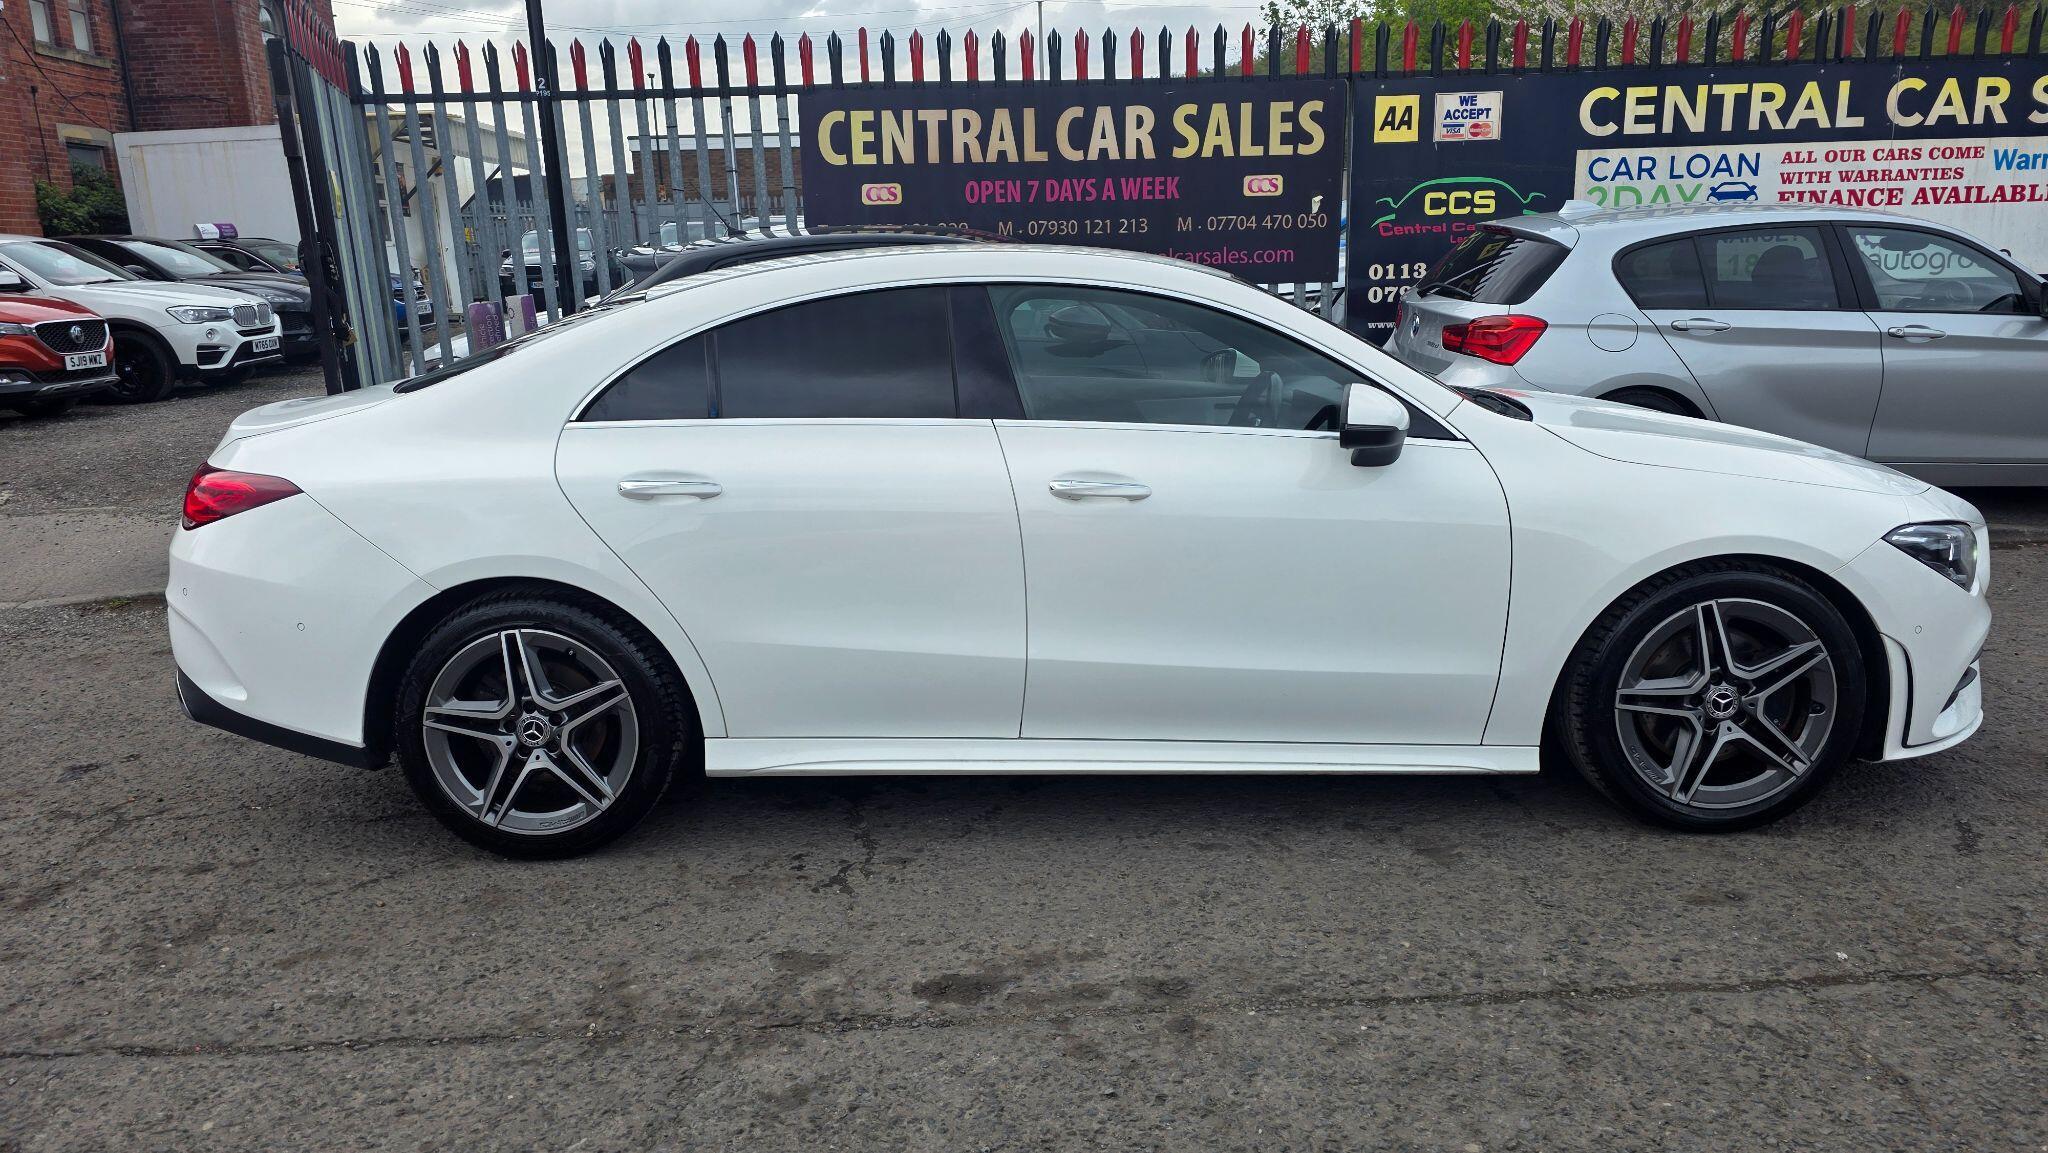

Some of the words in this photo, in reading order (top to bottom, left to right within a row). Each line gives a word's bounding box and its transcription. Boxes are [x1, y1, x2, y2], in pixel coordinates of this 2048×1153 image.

[538, 78, 546, 89] 2
[1459, 95, 1478, 106] WE
[1579, 80, 1865, 137] CENTRAL
[1886, 76, 2011, 127] CAR
[1379, 105, 1413, 131] AA
[1444, 108, 1492, 120] ACCEPT
[818, 107, 1049, 166] CENTRAL
[1056, 105, 1156, 161] CAR
[1172, 100, 1325, 159] SALES
[1781, 150, 1818, 164] ALL
[1824, 149, 1866, 163] OUR
[1873, 147, 1922, 161] CARS
[1928, 146, 1986, 160] COME
[1588, 156, 1657, 182] CAR
[1669, 152, 1761, 179] LOAN
[1780, 171, 1831, 185] WITH
[1838, 167, 1965, 183] WARRANTIES
[866, 186, 898, 202] CCS
[965, 181, 1021, 204] OPEN
[1027, 180, 1039, 203] 7
[1046, 178, 1097, 202] DAYS
[1102, 178, 1116, 201] A
[1120, 176, 1180, 200] WEEK
[1248, 178, 1279, 193] CCS
[1424, 190, 1496, 216] CCS
[1587, 184, 1703, 208] 2DAY
[1778, 187, 1904, 207] FINANCE
[998, 222, 1013, 236] M
[1028, 220, 1078, 235] 07930
[1084, 219, 1112, 234] 121
[1120, 218, 1148, 233] 213
[1177, 216, 1191, 231] M
[1207, 215, 1256, 231] 07704
[1262, 214, 1292, 230] 470
[1297, 213, 1327, 228] 050
[1378, 222, 1446, 237] Central
[1452, 222, 1476, 232] Ca
[1368, 262, 1427, 280] 0113
[1869, 250, 1985, 275] autogro
